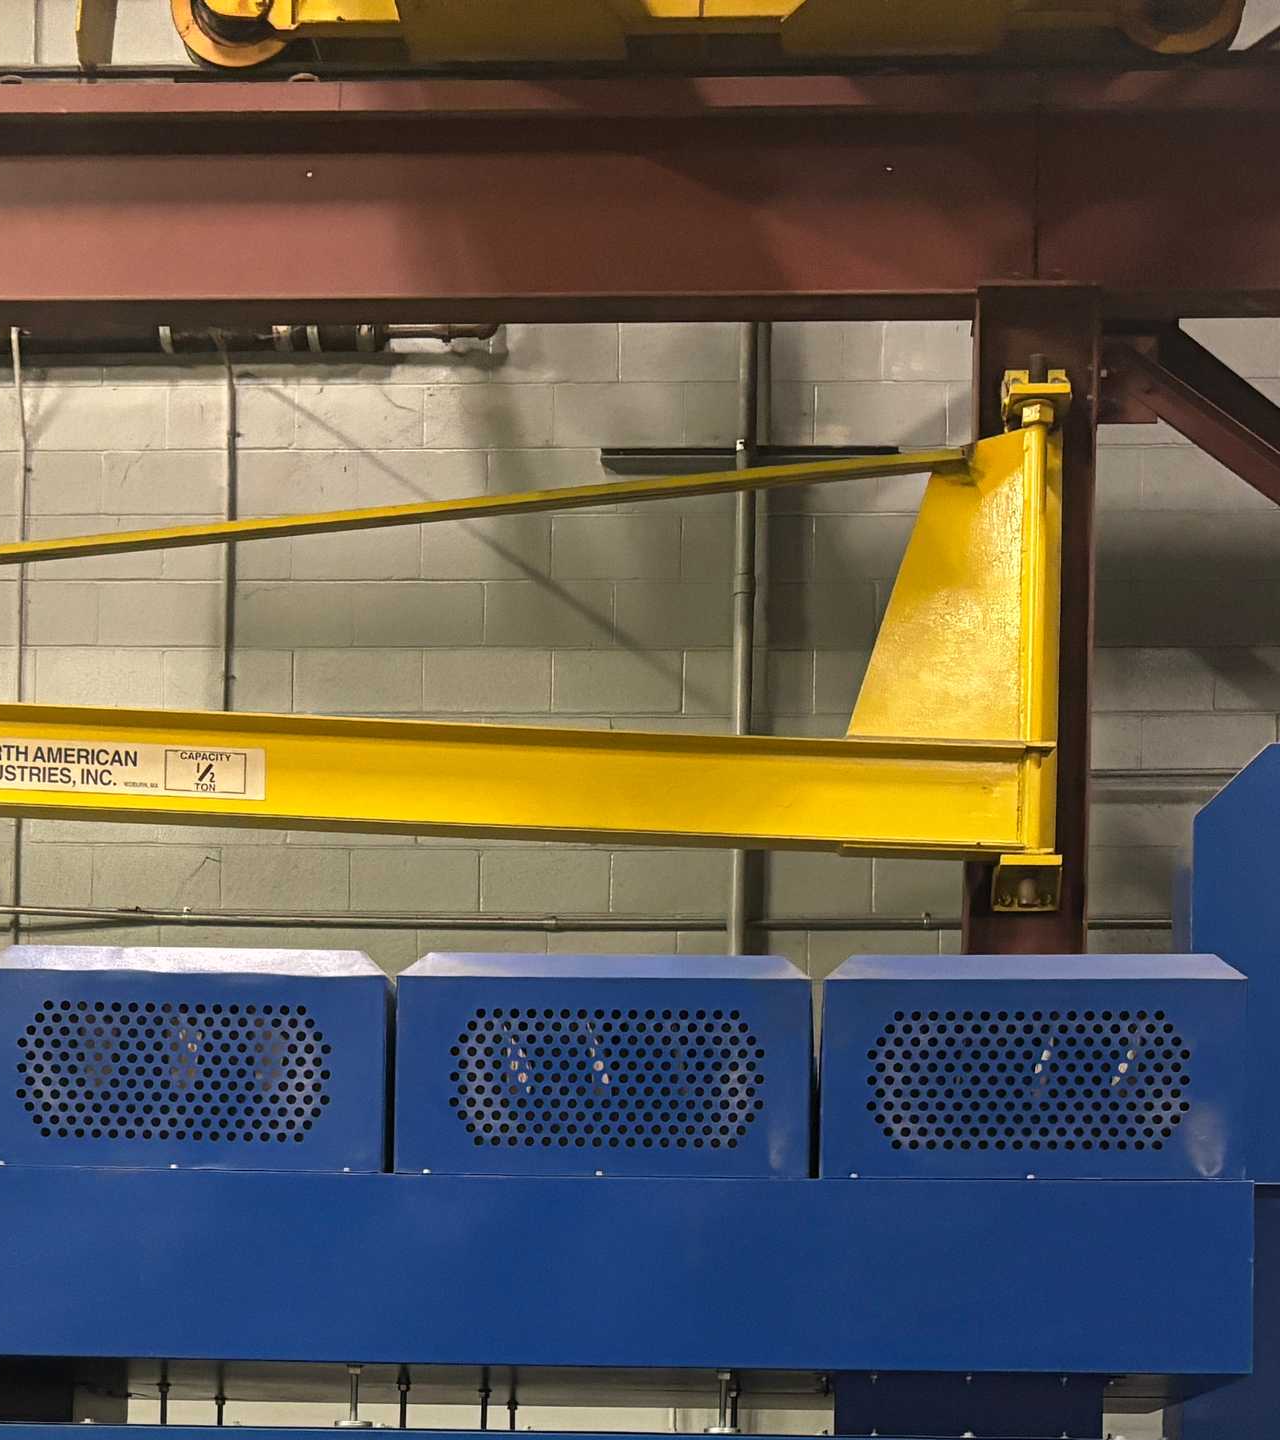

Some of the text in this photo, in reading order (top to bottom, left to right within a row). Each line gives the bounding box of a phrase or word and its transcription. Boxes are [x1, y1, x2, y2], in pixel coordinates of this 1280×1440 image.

[32, 747, 138, 767] AMERICAN
[180, 751, 232, 762] CAPACITY
[81, 768, 117, 787] INC.
[194, 782, 216, 792] TON
